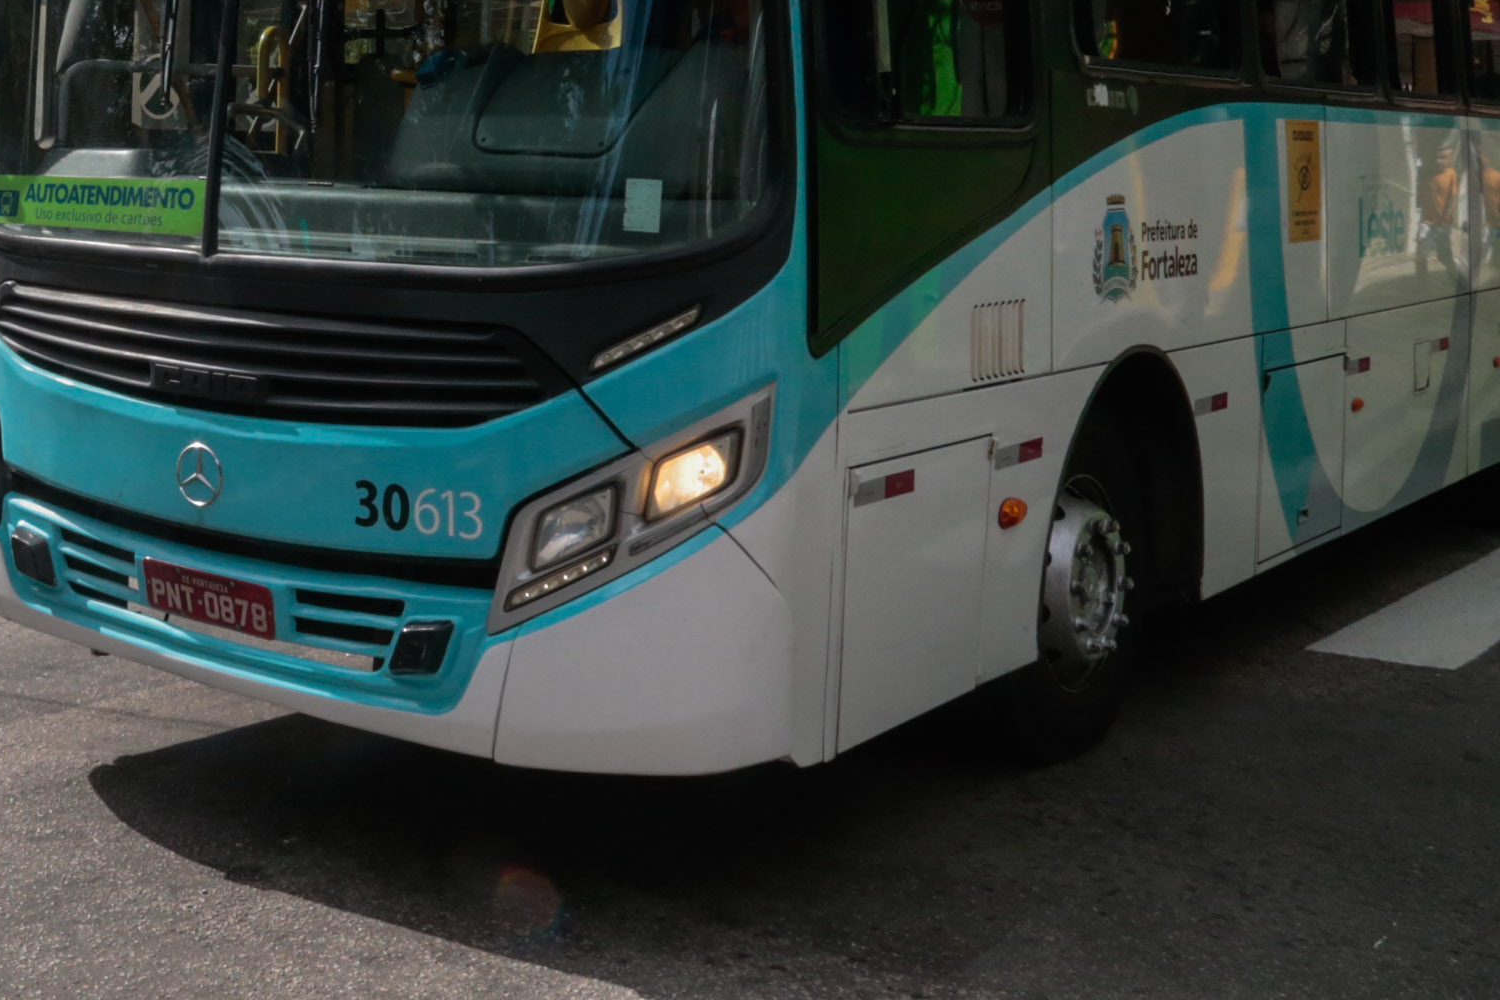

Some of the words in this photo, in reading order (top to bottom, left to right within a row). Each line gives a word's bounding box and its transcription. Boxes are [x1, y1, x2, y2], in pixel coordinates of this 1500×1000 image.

[25, 183, 195, 210] AUTOATENDIMENTO
[35, 207, 53, 220] Uso
[55, 207, 101, 223] exclusivo
[104, 209, 118, 224] de
[1141, 220, 1186, 241] Prefeitura
[1187, 218, 1198, 239] de
[1141, 245, 1198, 281] Fortaleza
[355, 479, 484, 540] 30613
